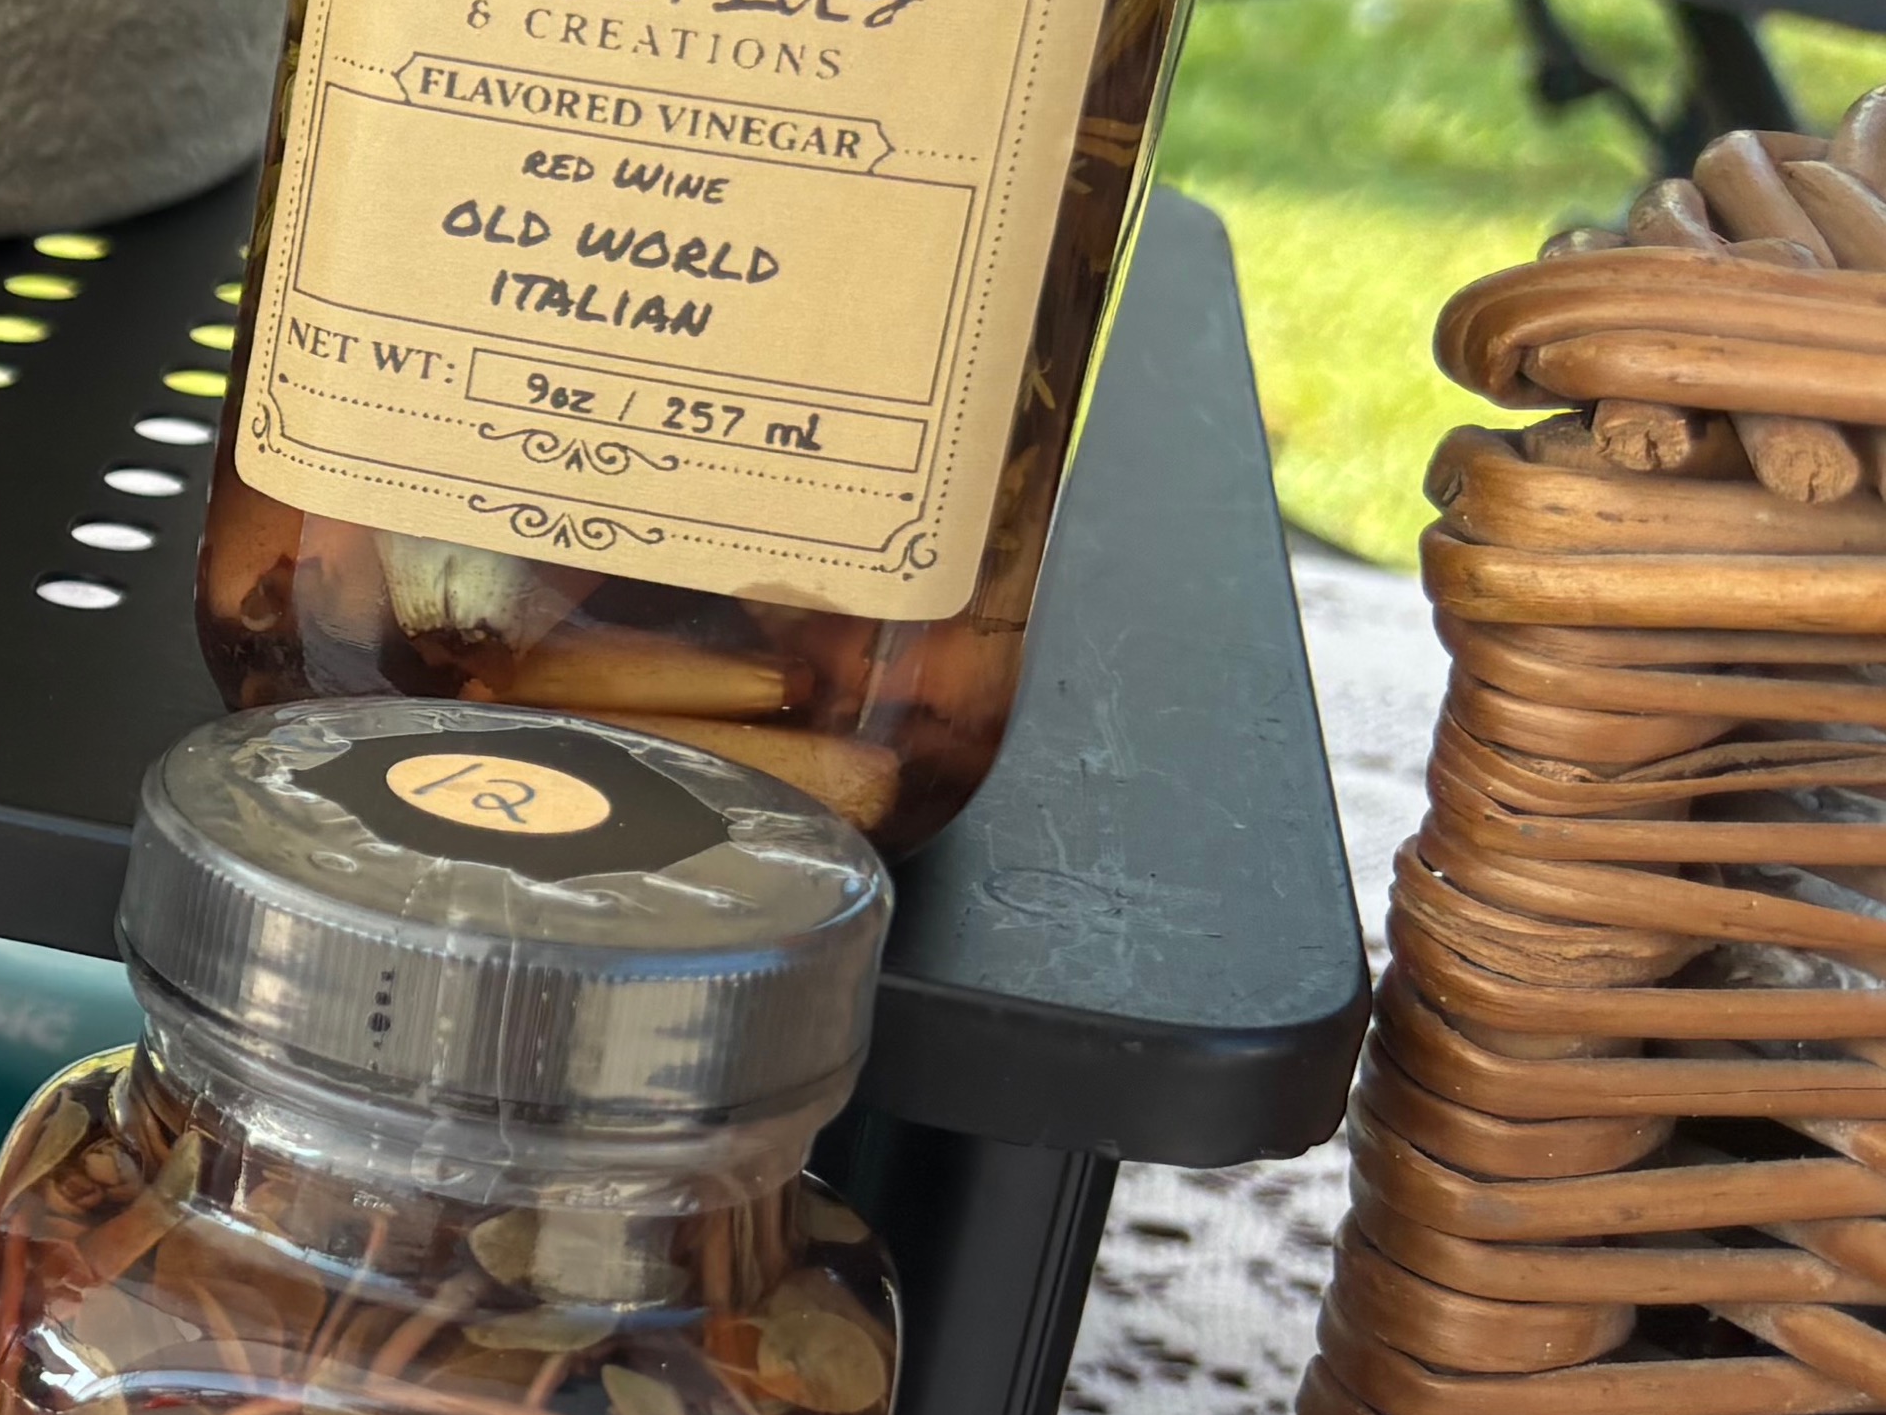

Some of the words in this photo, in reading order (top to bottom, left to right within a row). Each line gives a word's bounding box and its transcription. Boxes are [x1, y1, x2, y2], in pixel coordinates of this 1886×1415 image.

[466, 0, 491, 29] &
[524, 7, 843, 80] CREATIONS
[418, 66, 642, 128] FLAVORED
[659, 103, 862, 159] VINEGAR
[522, 150, 595, 183] RED
[612, 157, 729, 205] WINE
[441, 198, 551, 247] OLD
[577, 222, 780, 285] WORLD
[491, 269, 713, 337] ITALIAN
[287, 317, 359, 364] NET
[372, 339, 457, 385] WT:
[661, 396, 746, 437] 257
